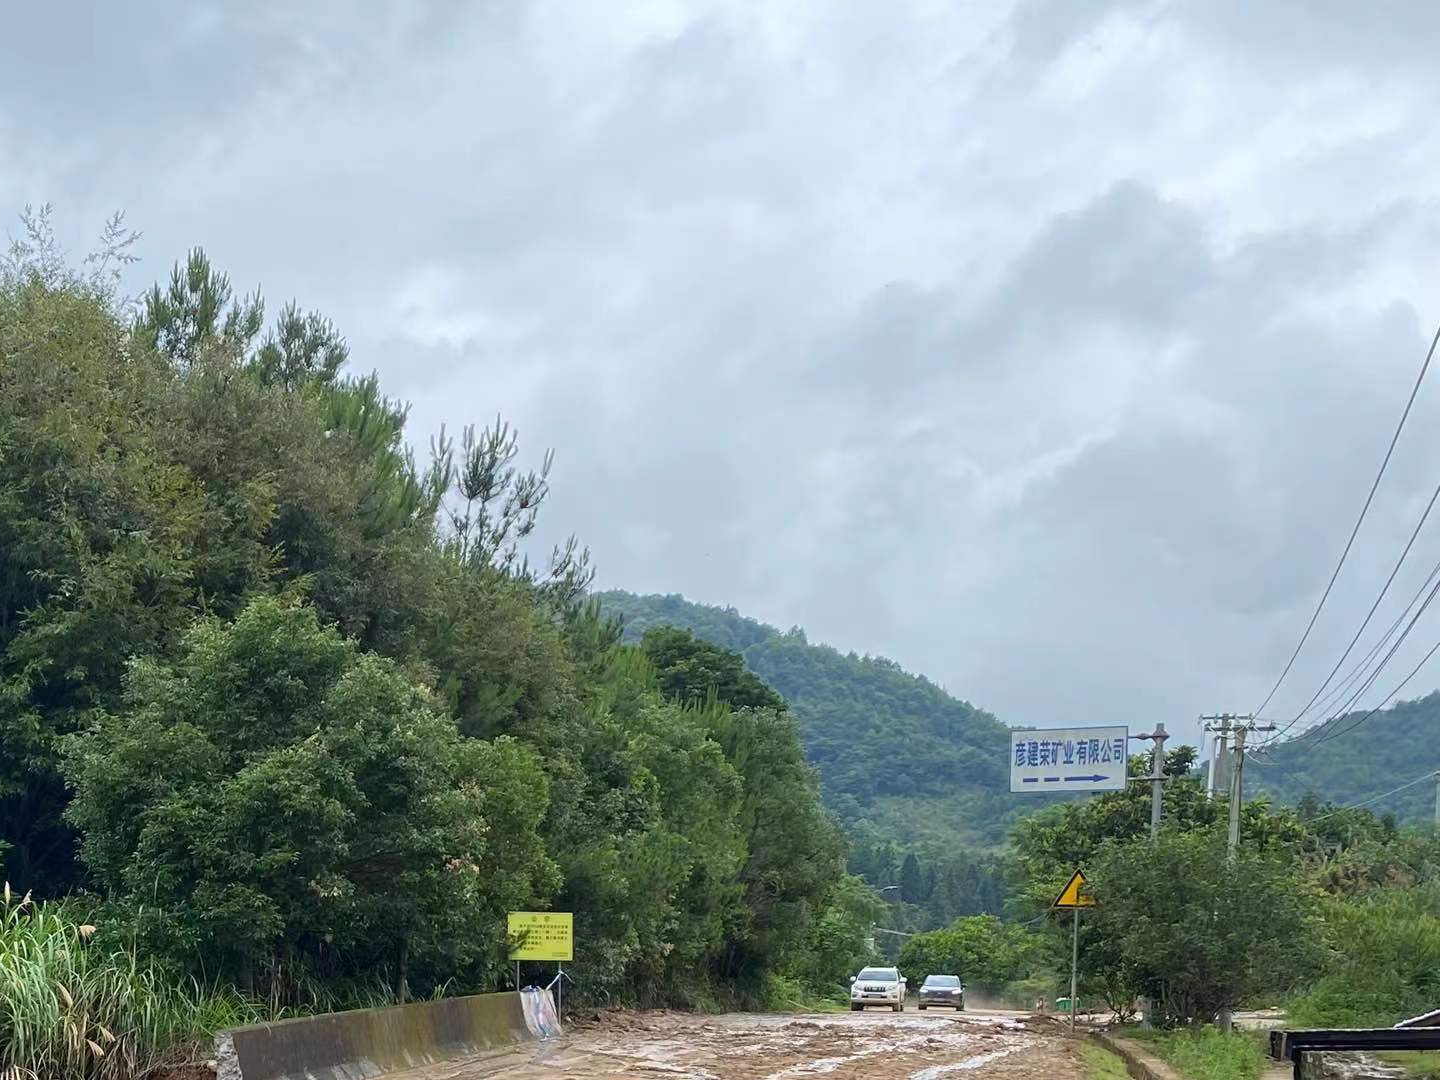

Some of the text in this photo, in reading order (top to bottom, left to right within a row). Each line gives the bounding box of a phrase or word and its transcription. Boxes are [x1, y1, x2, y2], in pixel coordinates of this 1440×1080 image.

[1015, 738, 1125, 767] 彦建荣矿业有限公司
